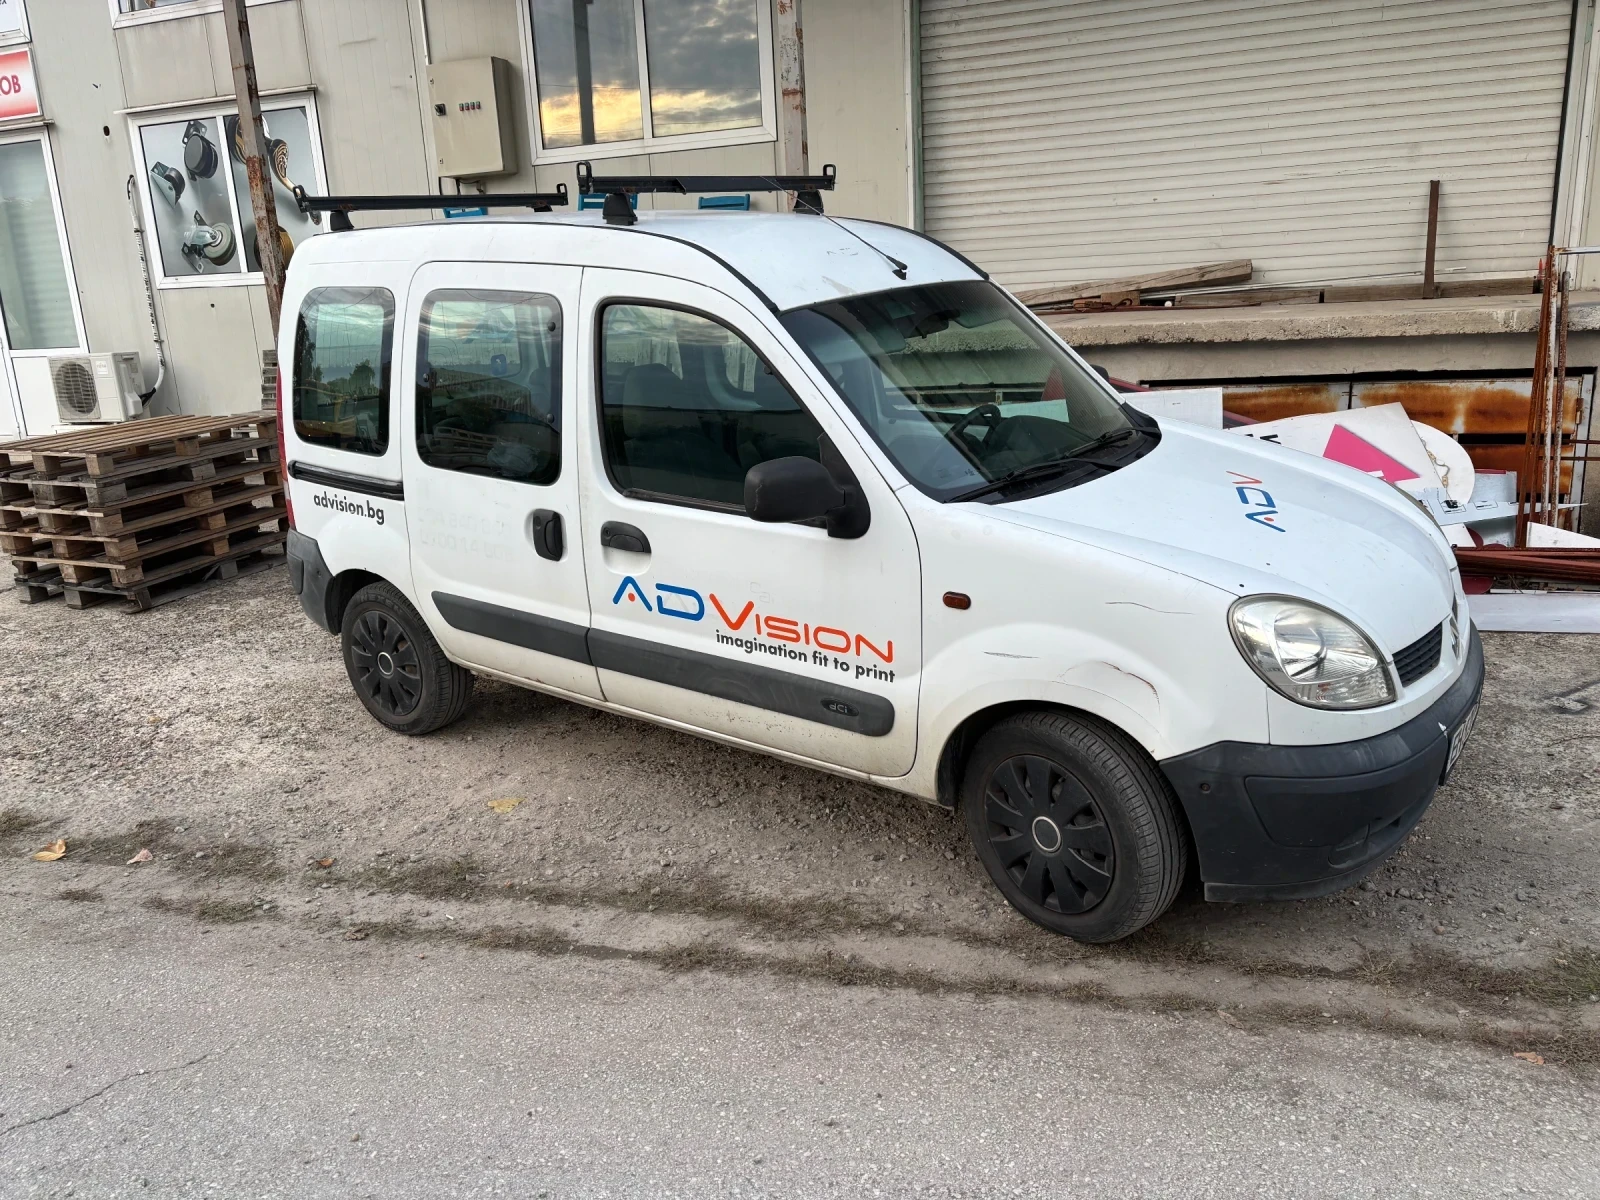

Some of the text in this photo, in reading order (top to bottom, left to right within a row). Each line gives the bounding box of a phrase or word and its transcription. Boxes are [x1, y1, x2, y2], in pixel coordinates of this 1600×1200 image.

[313, 491, 385, 525] advision.bg
[1226, 471, 1286, 532] ADV
[716, 629, 896, 683] imagination fit to print
